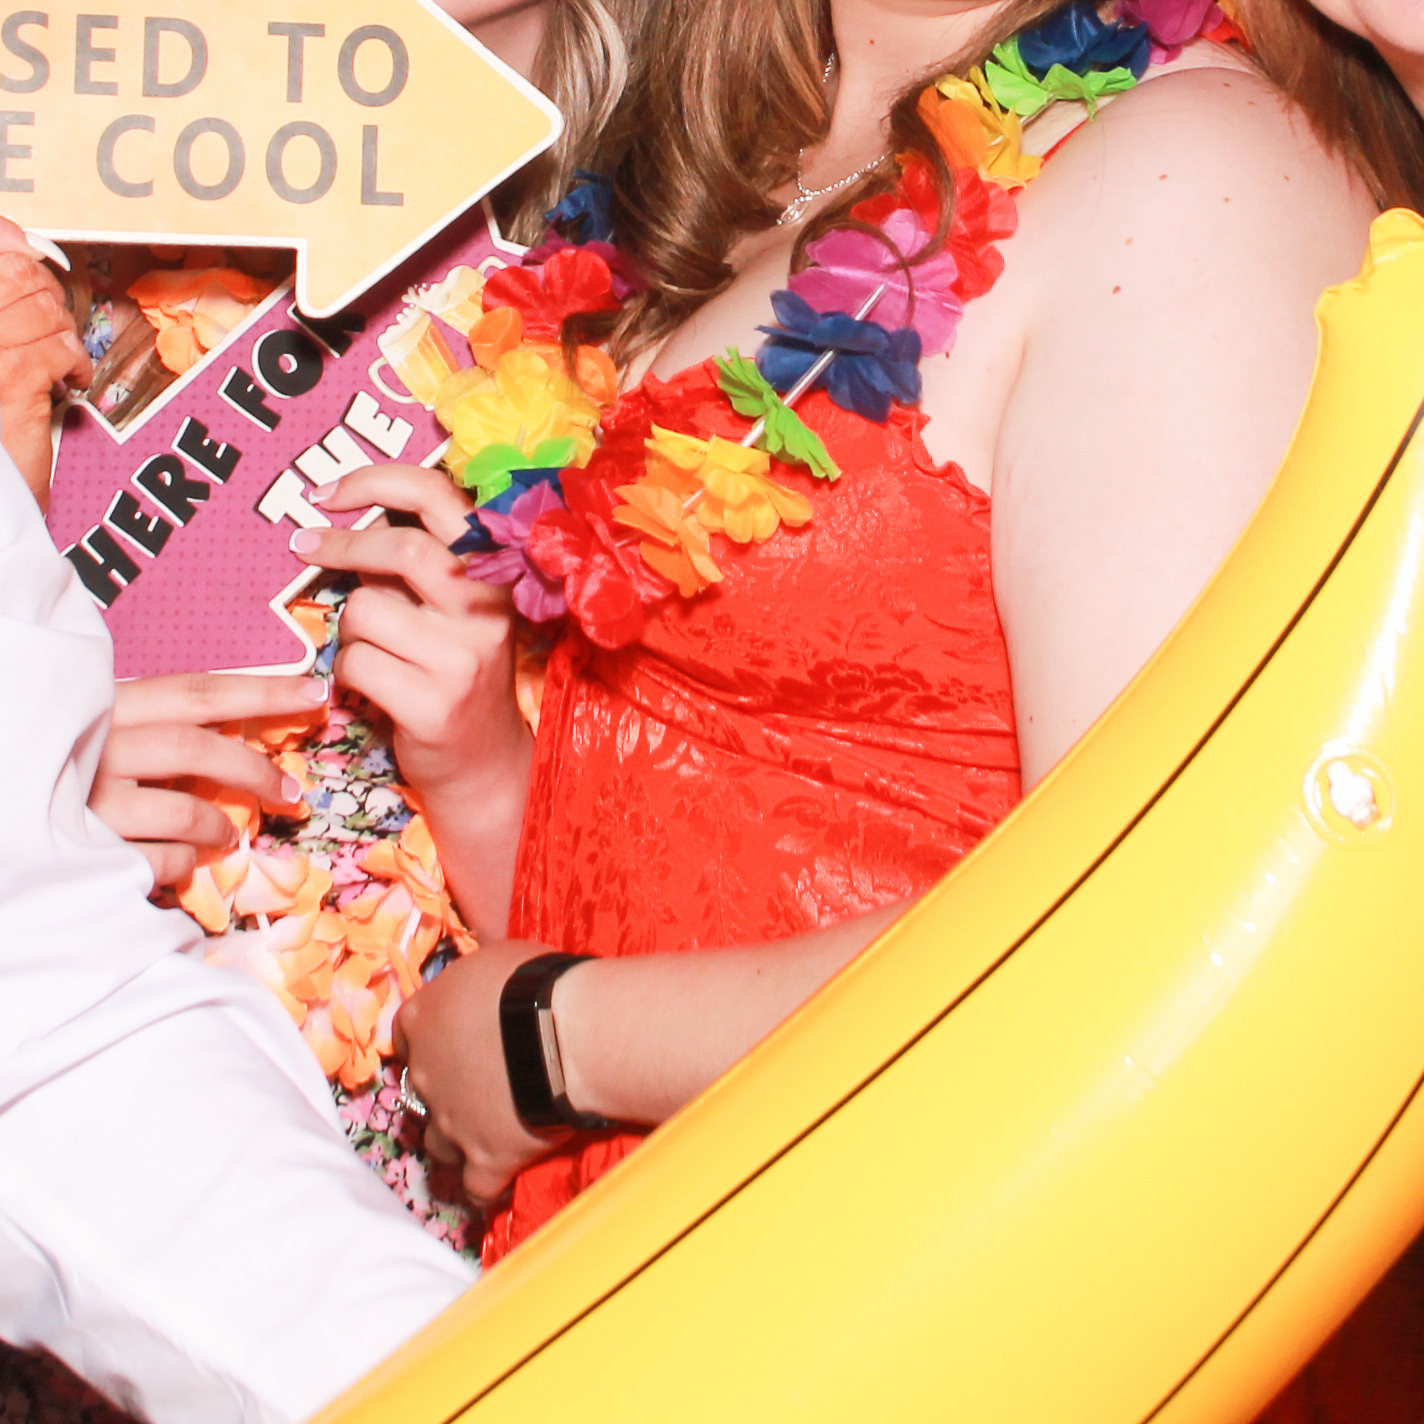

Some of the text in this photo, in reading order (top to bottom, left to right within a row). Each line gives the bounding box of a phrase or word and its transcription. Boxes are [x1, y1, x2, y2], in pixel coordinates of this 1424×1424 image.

[267, 21, 411, 108] TO
[96, 114, 405, 207] COOL
[60, 416, 243, 610] HERE
[257, 390, 414, 530] THE
